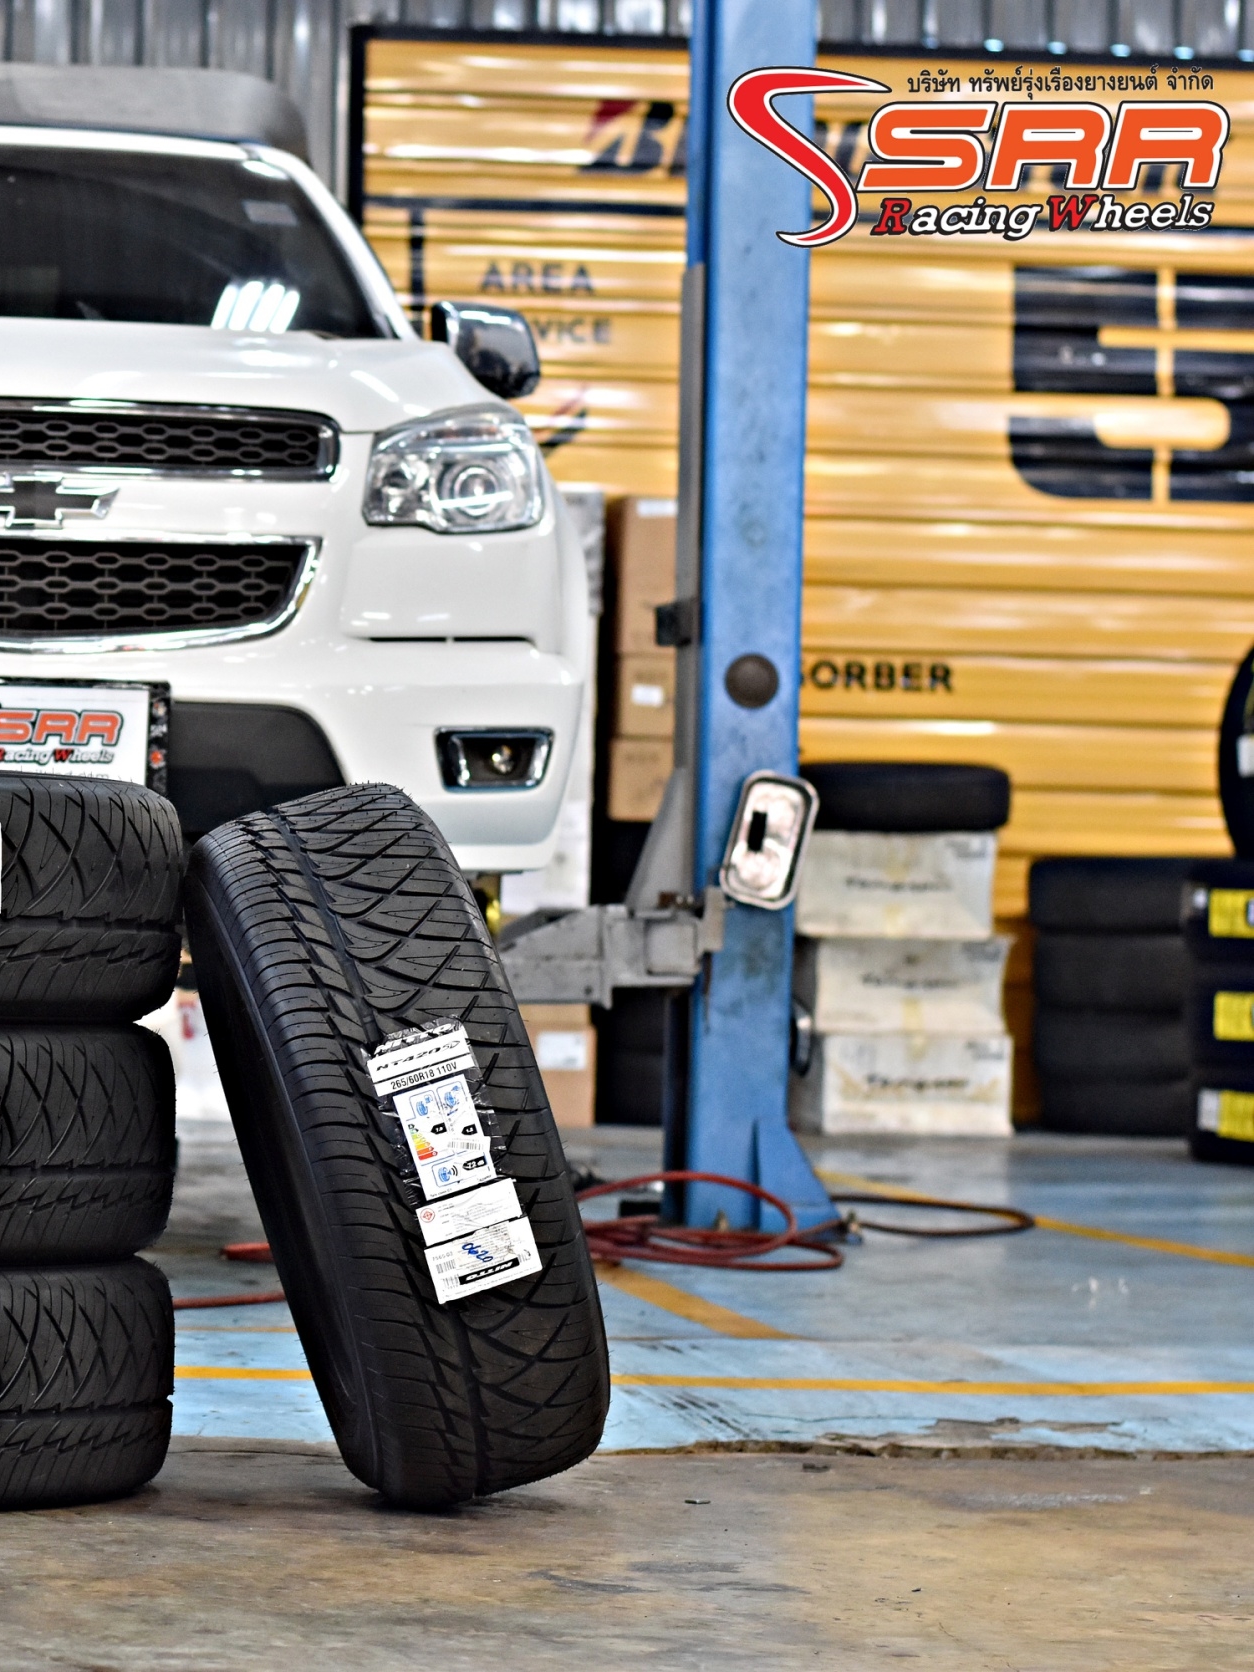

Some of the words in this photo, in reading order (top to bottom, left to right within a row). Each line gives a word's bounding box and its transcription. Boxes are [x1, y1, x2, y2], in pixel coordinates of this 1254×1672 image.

[481, 262, 595, 296] AREA
[532, 316, 612, 345] VICE
[809, 660, 953, 693] ORBER
[53, 747, 115, 764] Wheels
[390, 1070, 435, 1090] 265/60R18
[437, 1062, 458, 1079] 110V
